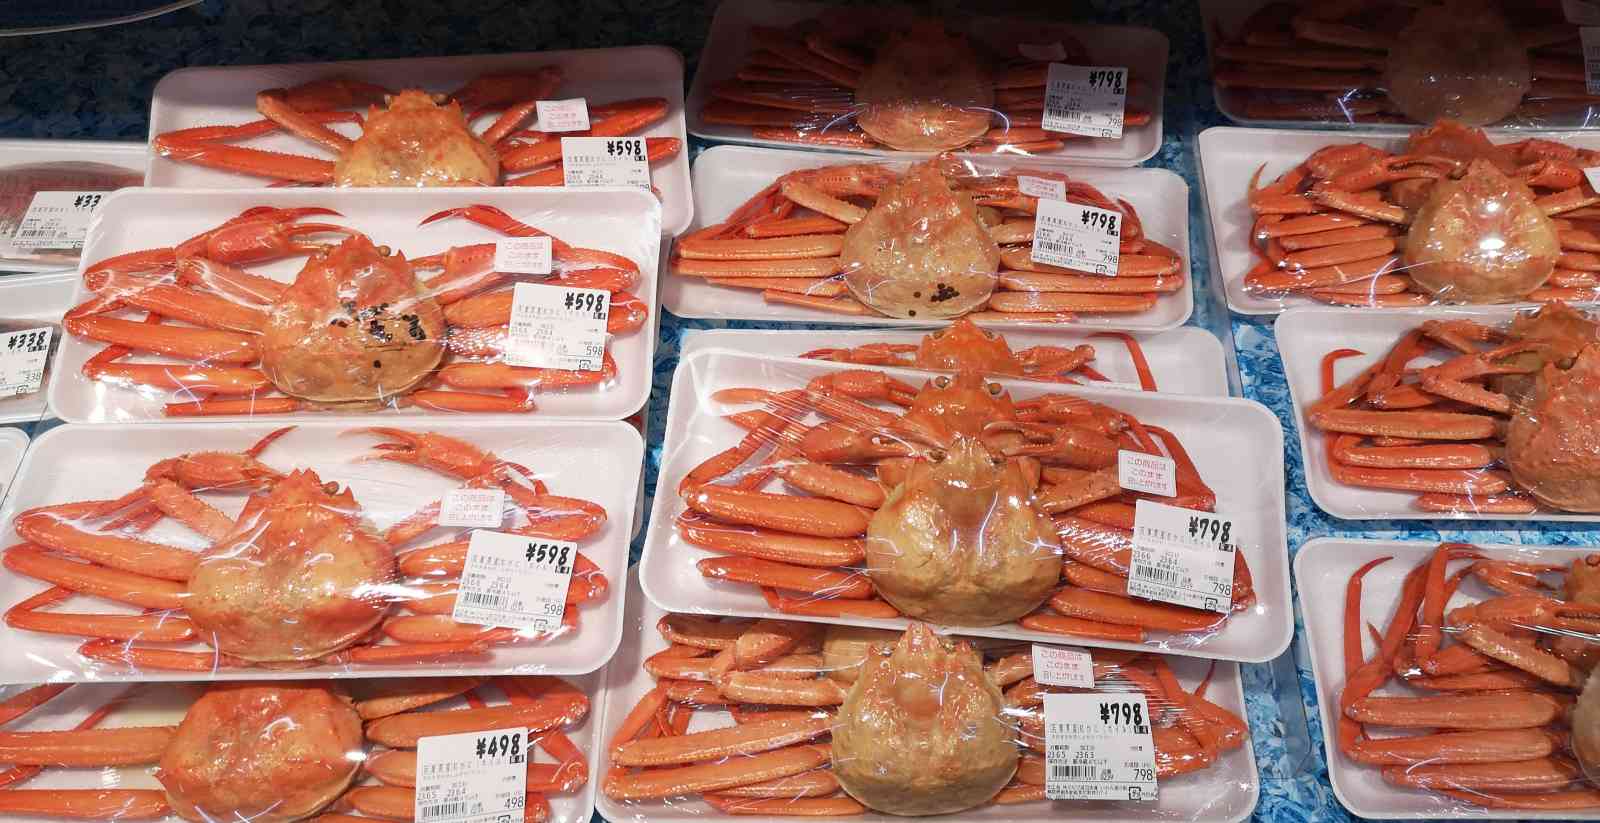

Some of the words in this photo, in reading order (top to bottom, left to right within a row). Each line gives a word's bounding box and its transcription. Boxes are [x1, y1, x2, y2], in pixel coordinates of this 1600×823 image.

[1089, 70, 1122, 88] ¥798
[607, 140, 641, 156] ¥598
[74, 195, 101, 208] ¥33
[1081, 209, 1117, 231] ¥798
[565, 292, 605, 313] ¥598
[8, 331, 46, 350] ¥338
[586, 345, 603, 356] 598
[1127, 457, 1167, 471] この商品は
[1130, 467, 1165, 479] このまま
[1189, 516, 1232, 543] ¥798
[525, 542, 570, 567] ¥598
[1213, 581, 1232, 596] 798
[543, 603, 563, 616] 598
[1040, 650, 1083, 661] この商品は
[1046, 662, 1079, 670] このまま
[1100, 703, 1142, 725] ¥798
[476, 733, 520, 759] ¥498
[1133, 768, 1153, 781] 798
[504, 796, 524, 809] 498
